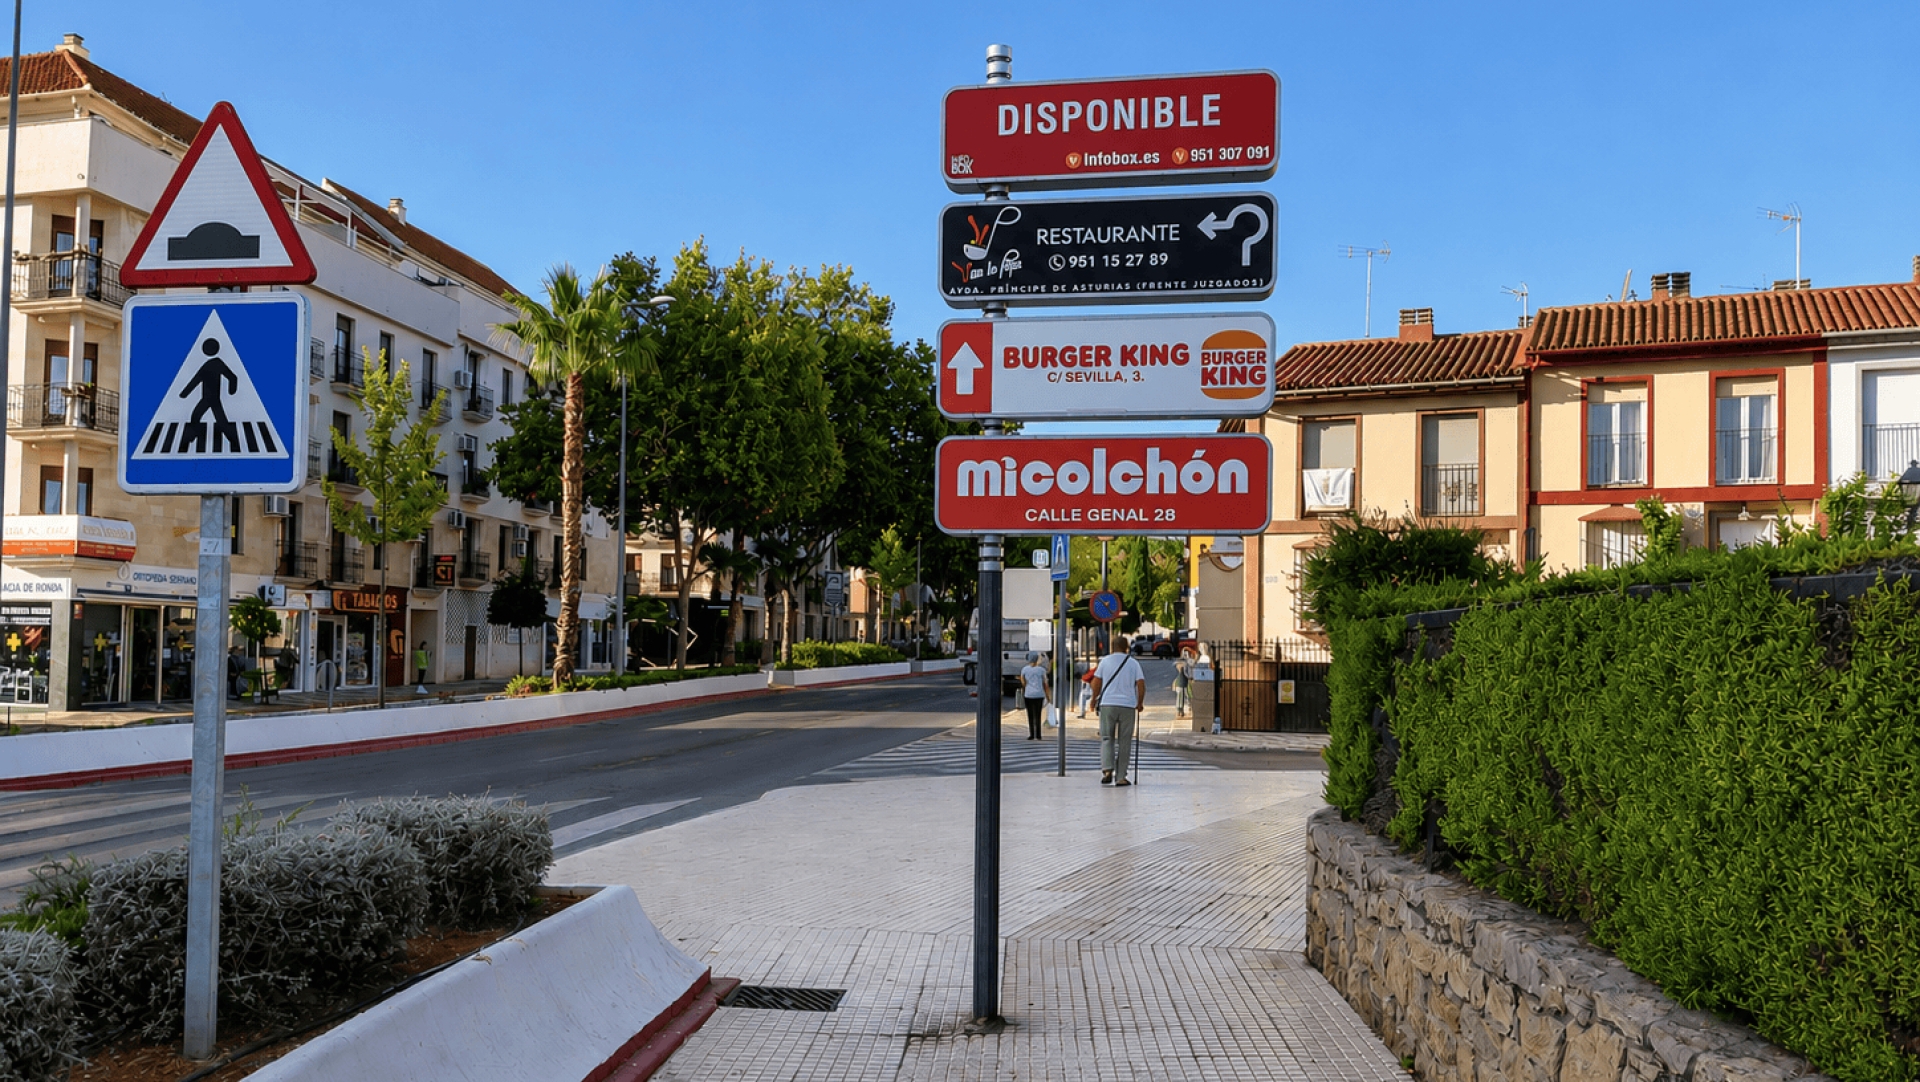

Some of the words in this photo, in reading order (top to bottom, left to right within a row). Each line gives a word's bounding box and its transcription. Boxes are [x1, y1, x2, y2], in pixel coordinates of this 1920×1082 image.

[998, 94, 1221, 136] DISPONIBLE
[1190, 148, 1213, 162] 951
[1219, 146, 1242, 160] 307
[1247, 145, 1270, 159] 091
[1036, 223, 1181, 245] RESTAURANTE
[1068, 255, 1095, 268] 951
[1102, 254, 1120, 267] 15
[1125, 253, 1144, 267] 27
[1149, 252, 1169, 266] 89
[1052, 284, 1067, 292] DE
[1072, 282, 1131, 292] ASTURIAS
[1136, 280, 1187, 290] (FRENTE
[1192, 278, 1264, 289] JUZGADOS)
[1003, 345, 1111, 369] BURGER
[1119, 343, 1190, 366] KING
[1200, 351, 1267, 366] BURGER
[1047, 371, 1063, 384] C/
[1065, 370, 1128, 384] SEVILLA,
[1132, 370, 1145, 382] 3.
[1200, 365, 1267, 386] KING
[957, 447, 1249, 497] micolchón
[1025, 508, 1082, 522] CALLE
[1087, 508, 1149, 522] GENAL
[1154, 508, 1176, 522] 28
[23, 582, 34, 593] DE
[36, 582, 63, 593] RONDA
